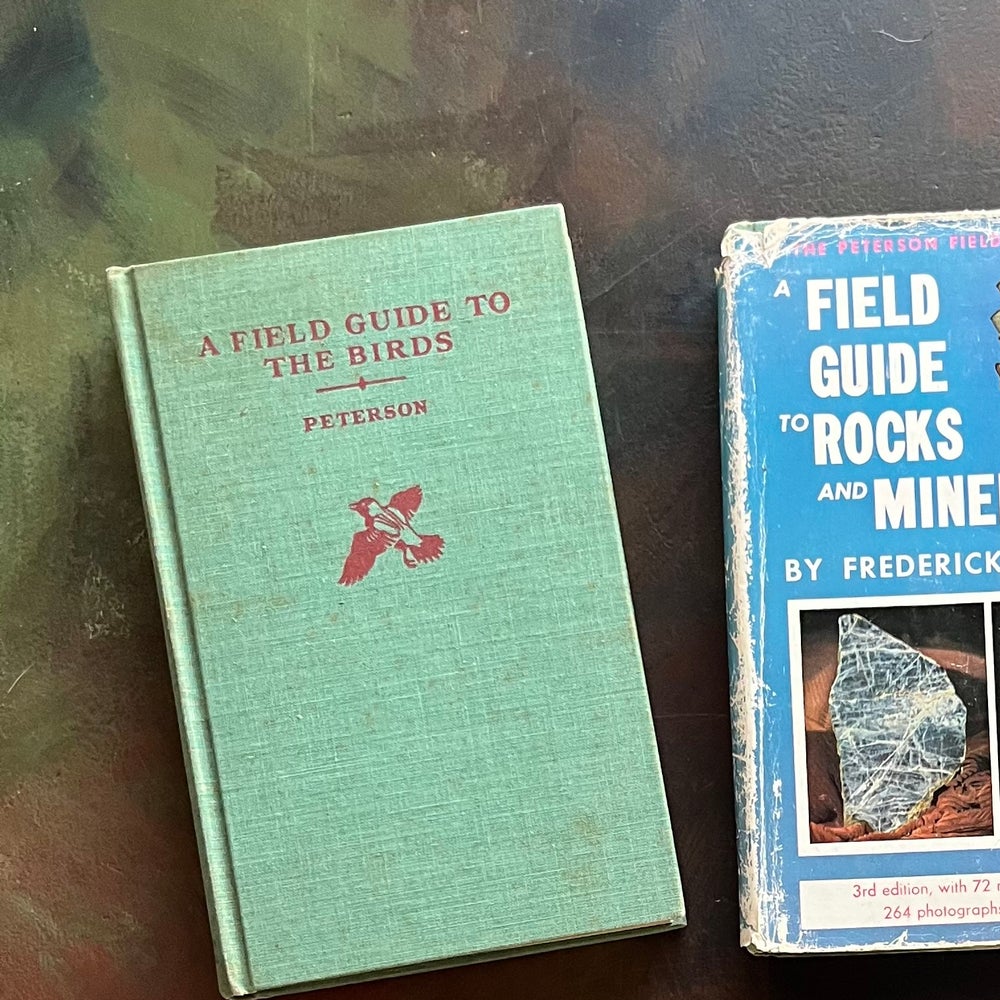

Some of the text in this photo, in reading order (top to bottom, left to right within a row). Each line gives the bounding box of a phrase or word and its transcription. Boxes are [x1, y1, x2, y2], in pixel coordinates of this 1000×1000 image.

[793, 242, 827, 256] THE
[838, 236, 938, 254] PETERSON
[774, 274, 940, 330] A FIELD
[199, 291, 511, 357] A FIELD GUIDE TO
[264, 332, 453, 378] THE BIRDS
[810, 341, 948, 399] GUIDE
[303, 400, 428, 433] PETERSON
[780, 408, 964, 465] TO ROCKS
[817, 482, 868, 501] AND
[784, 559, 823, 583] BY
[852, 884, 878, 898] 3rd
[881, 881, 933, 898] edition,
[938, 879, 967, 894] with
[973, 879, 991, 892] 72
[883, 906, 911, 920] 264
